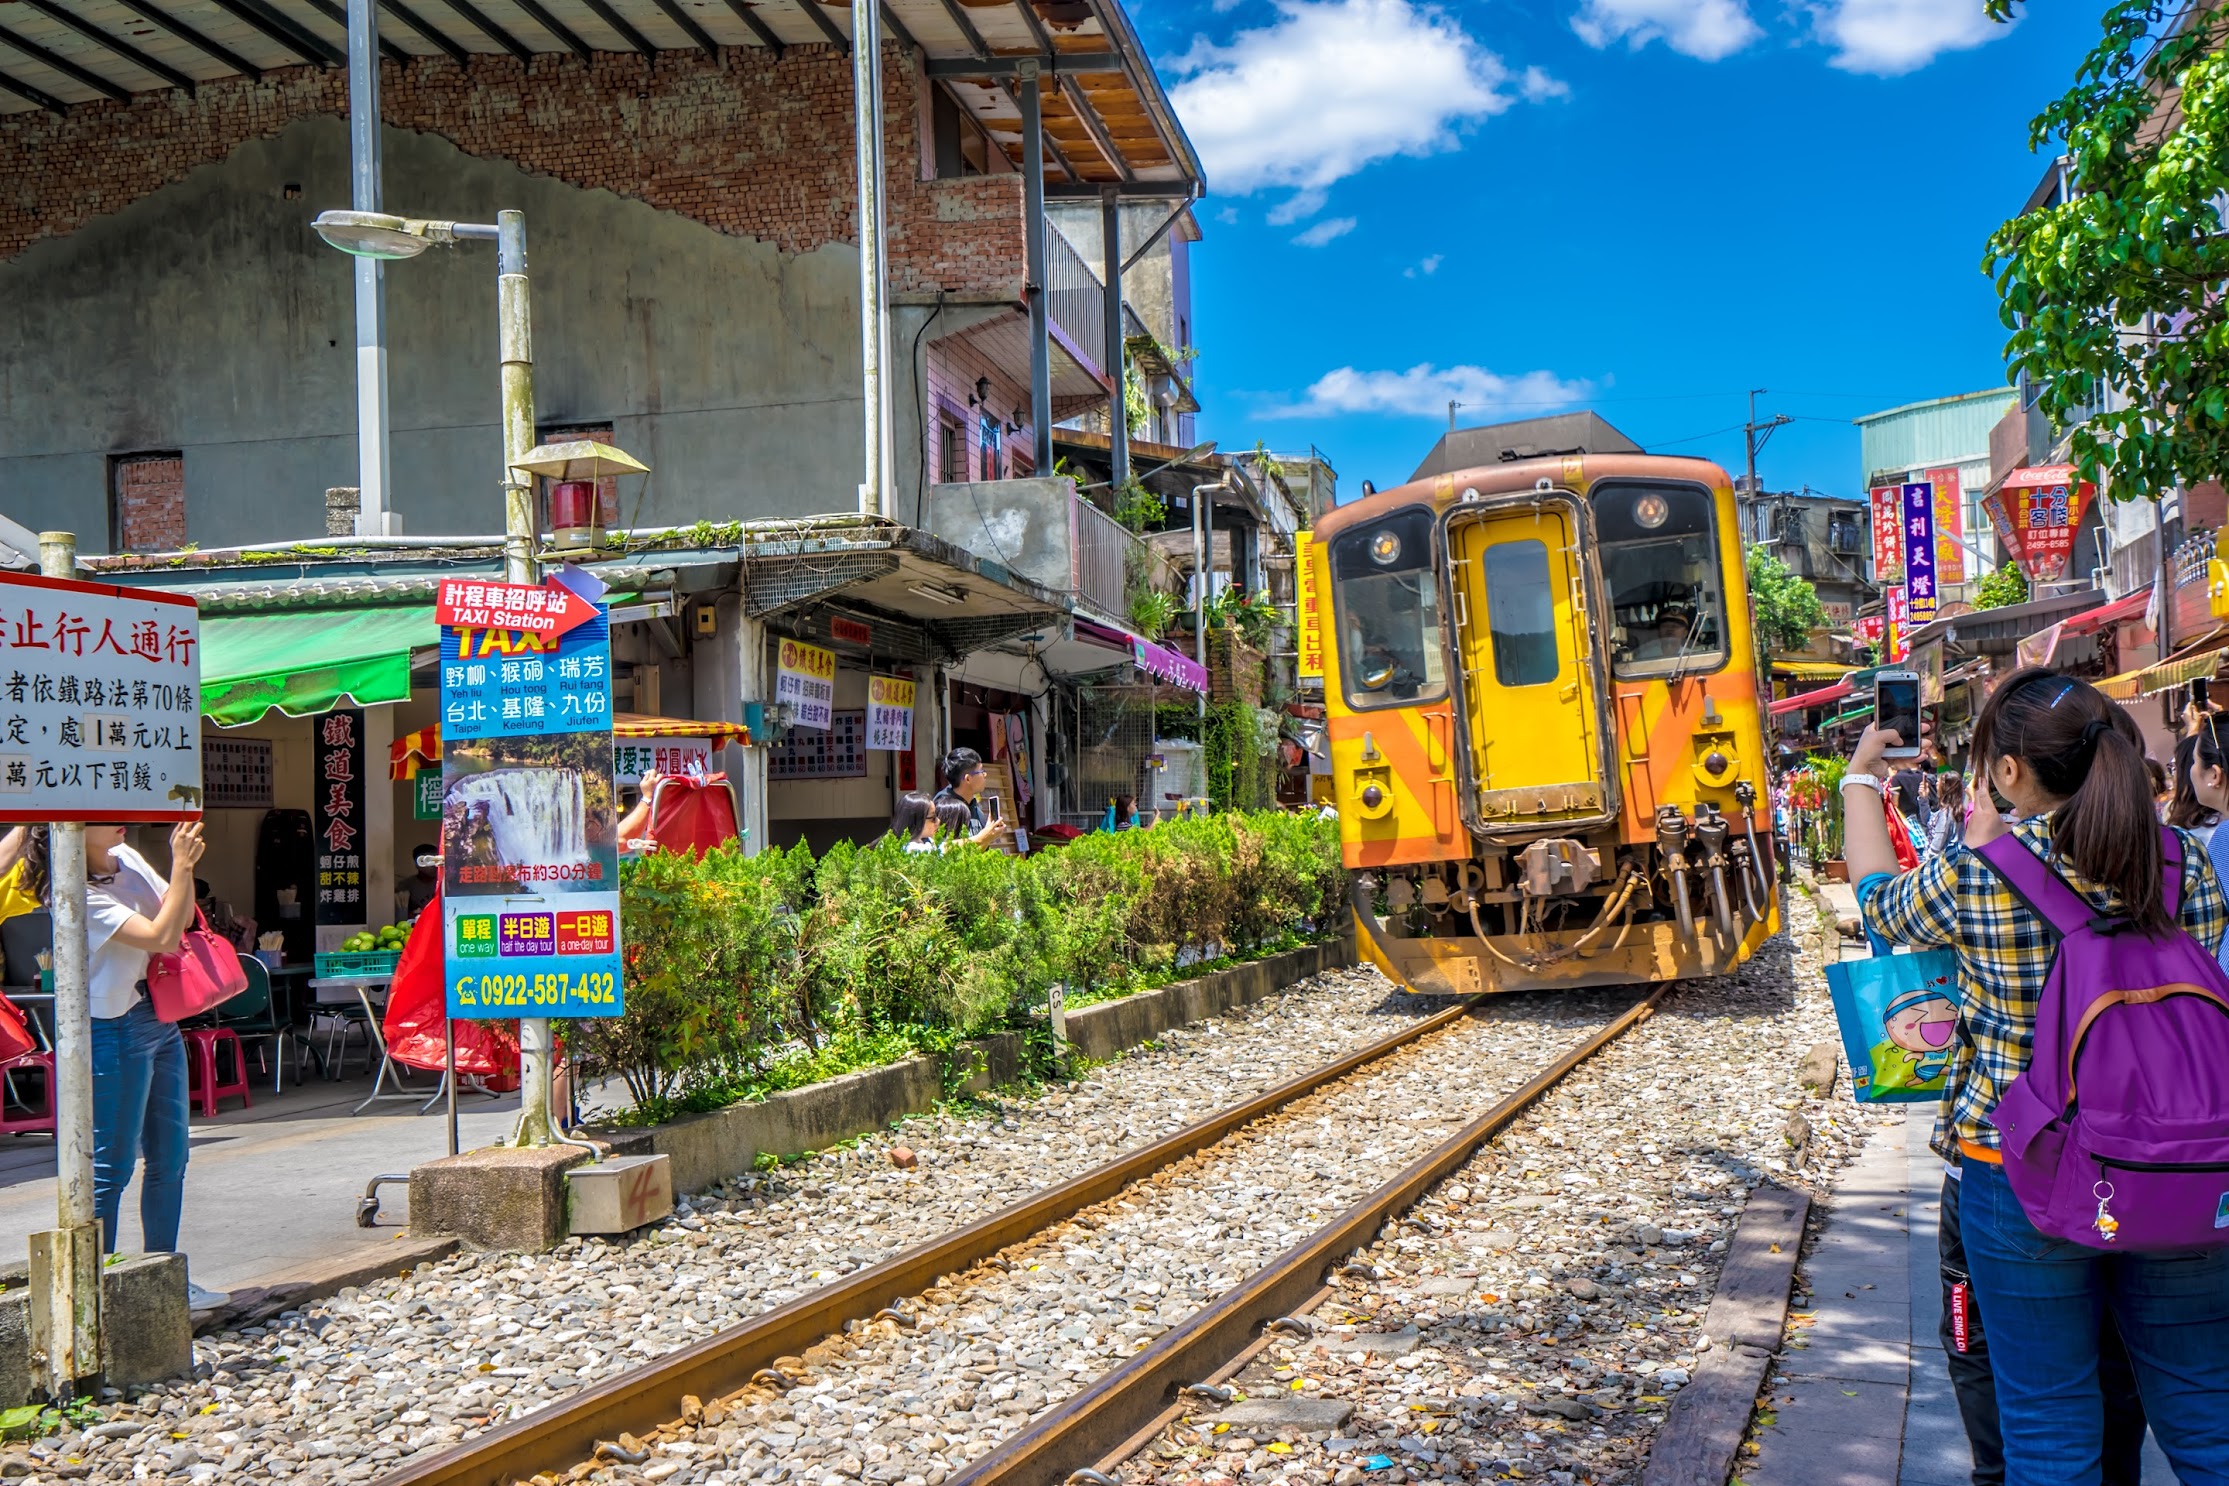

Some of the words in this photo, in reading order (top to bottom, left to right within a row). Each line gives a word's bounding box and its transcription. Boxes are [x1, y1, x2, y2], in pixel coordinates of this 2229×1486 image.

[2020, 469, 2069, 481] Coca-Cola
[2029, 486, 2068, 508] 十分
[2068, 487, 2079, 526] 小吃
[2029, 508, 2068, 528] 客棧
[1910, 487, 1932, 595] 吉利天燈
[445, 584, 568, 614] 計程車招呼站
[452, 608, 489, 624] TAXI
[493, 610, 554, 630] Station
[0, 608, 196, 667] 止行人通行
[0, 670, 194, 714] 者依鐵路法第70條
[451, 690, 469, 699] Yeh
[471, 689, 482, 698] liu
[501, 685, 521, 695] Hou
[524, 685, 547, 696] tong
[560, 681, 577, 691] Rui
[580, 680, 604, 692] fang
[0, 714, 192, 751] 定，處1萬元以上
[454, 723, 481, 734] Taipei
[503, 719, 544, 731] Keelung
[567, 716, 599, 727] Jiufen
[0, 760, 167, 792] 萬元以下罰鍰。
[322, 715, 357, 852] 鐵道美食
[320, 855, 359, 869] 蚵仔煎
[320, 872, 359, 886] 甜不辣
[320, 889, 359, 903] 炸雞排
[462, 918, 491, 941] 單程
[504, 916, 550, 940] 半日遊
[560, 915, 609, 938] 一日遊
[459, 944, 475, 953] one
[478, 944, 494, 955] way
[501, 941, 513, 952] half
[514, 941, 525, 951] the
[526, 941, 538, 953] day
[540, 941, 553, 952] tour
[595, 939, 609, 951] tour
[481, 972, 615, 1006] 0922-587-432
[628, 1164, 660, 1224] 4
[1953, 1295, 1963, 1314] LIVE
[1954, 1316, 1964, 1336] SING
